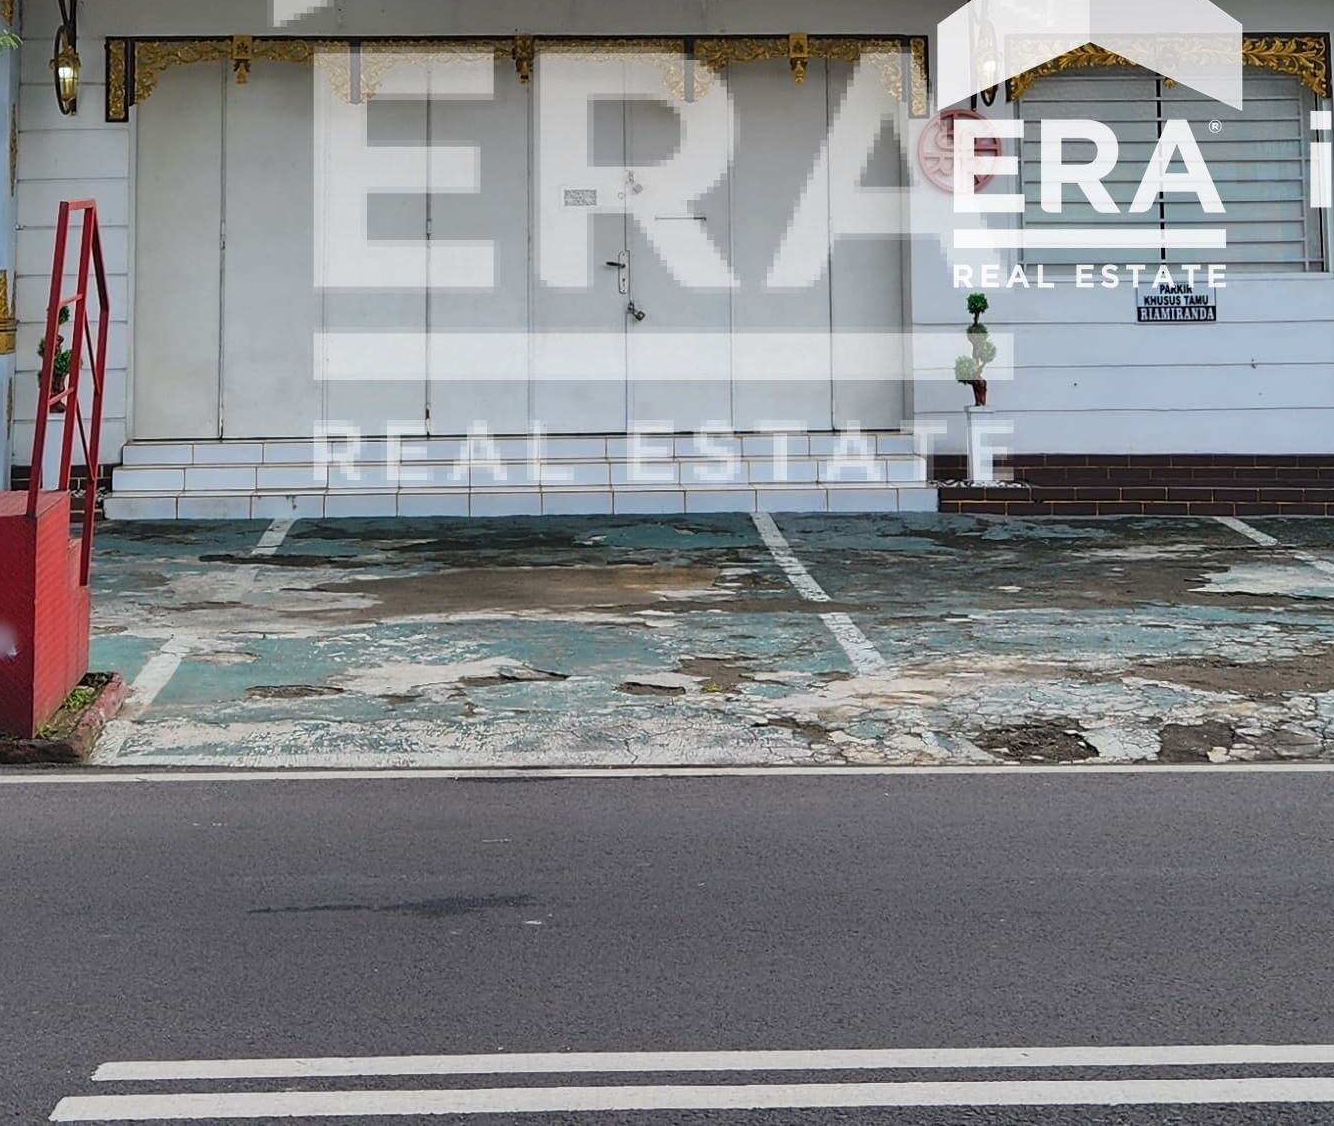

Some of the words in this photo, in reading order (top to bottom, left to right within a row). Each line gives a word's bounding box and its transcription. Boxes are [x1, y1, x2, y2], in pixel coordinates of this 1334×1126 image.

[1143, 295, 1181, 306] KHUSUS
[1183, 295, 1209, 305] TAMU
[1140, 307, 1215, 321] RIAMIRANDA
